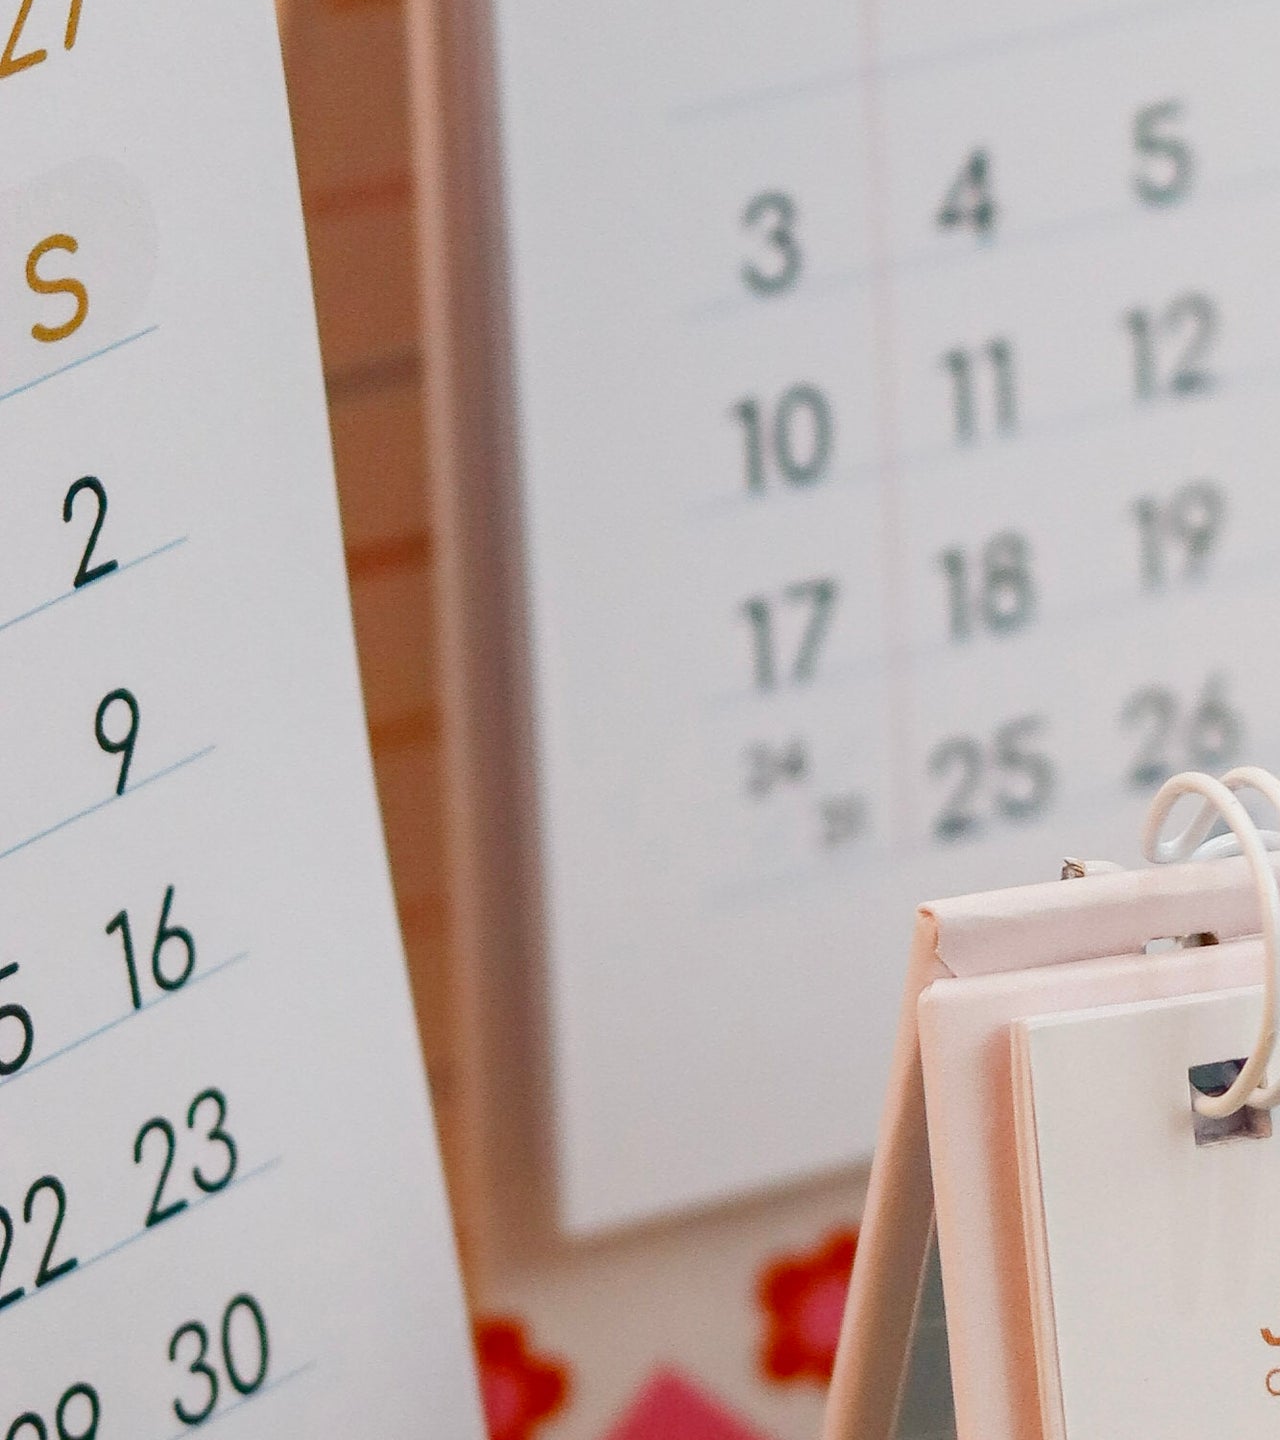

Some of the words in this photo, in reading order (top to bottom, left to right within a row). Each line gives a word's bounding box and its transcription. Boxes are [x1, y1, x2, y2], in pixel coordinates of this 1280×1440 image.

[738, 188, 806, 300] 3
[935, 147, 1001, 241] 4
[1129, 101, 1195, 209] 5
[26, 234, 88, 342] s
[731, 382, 836, 496] 10
[941, 337, 1019, 446] 11
[1122, 292, 1220, 402] 12
[63, 476, 118, 589] 2
[740, 579, 841, 695] 17
[939, 533, 1038, 641] 18
[1129, 481, 1227, 589] 19
[95, 688, 139, 796] 9
[930, 717, 1056, 844] 25
[1122, 679, 1244, 800] 26
[106, 886, 195, 1011] 16
[134, 1089, 237, 1229] 23
[169, 1294, 268, 1427] 30
